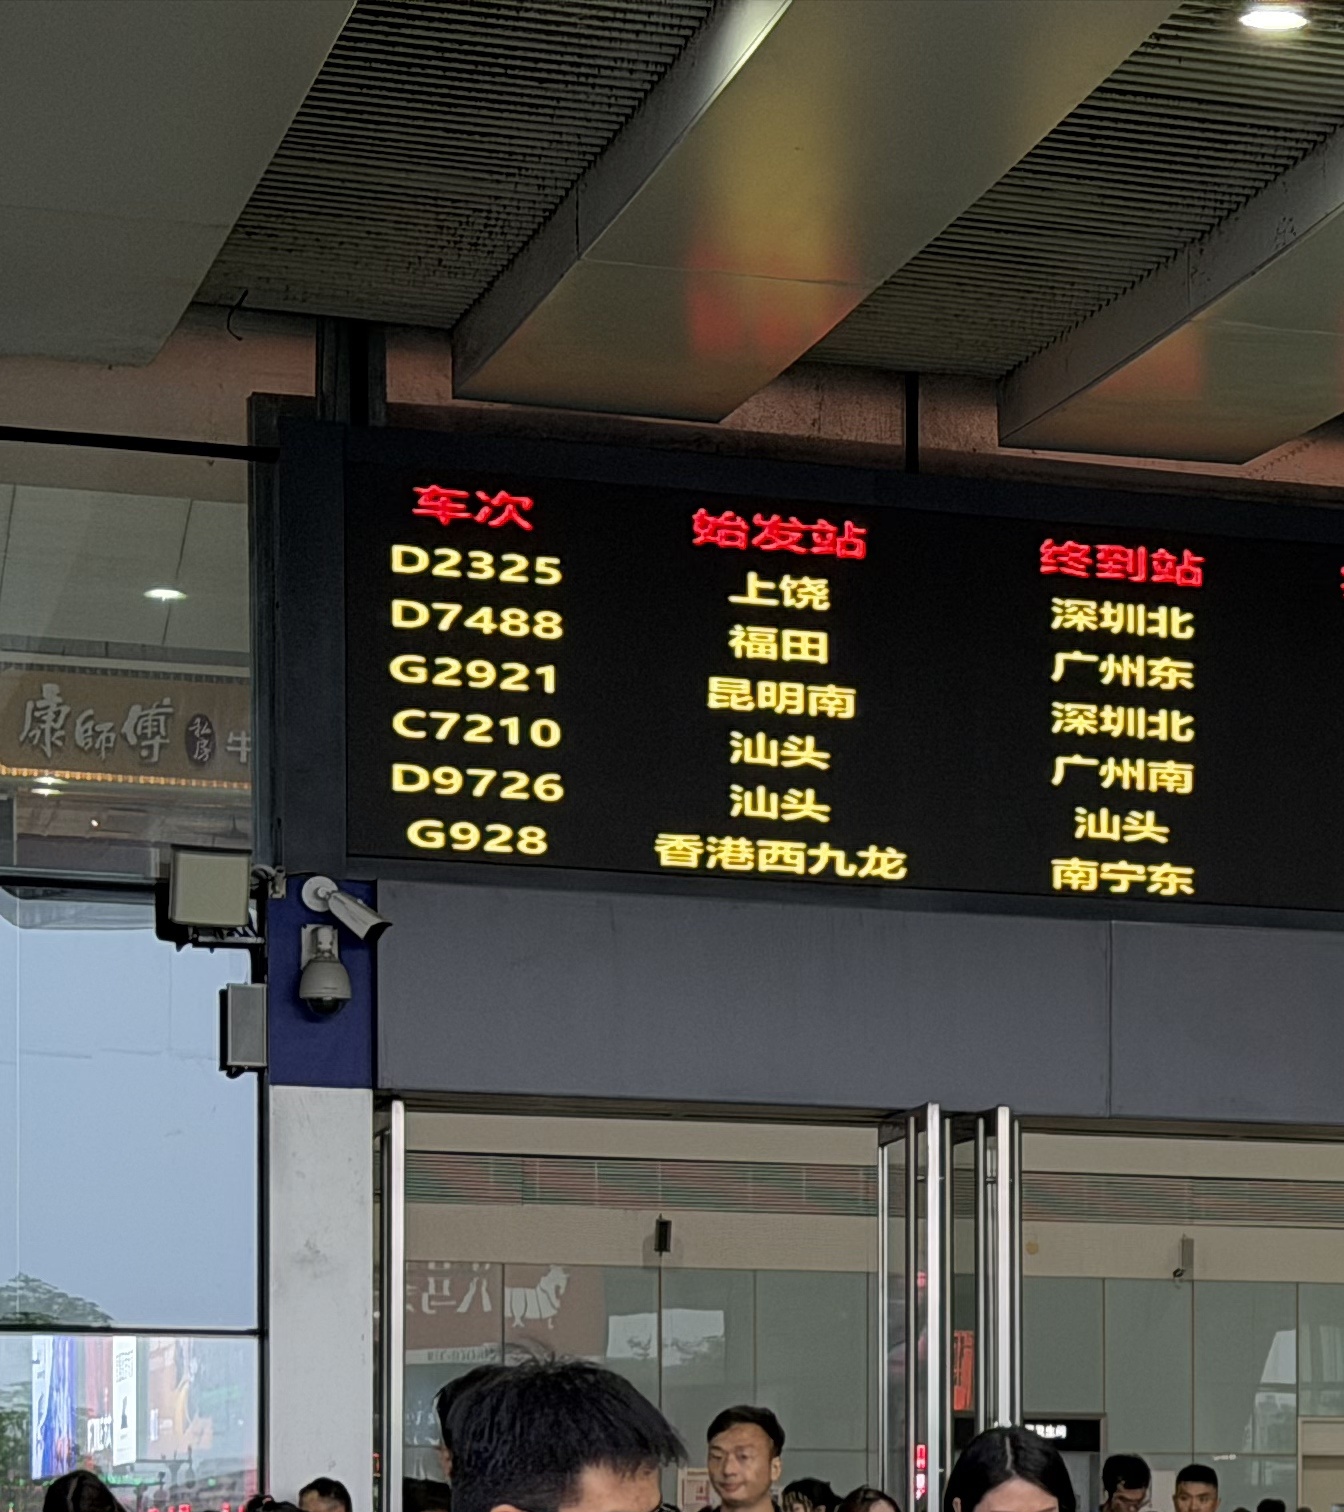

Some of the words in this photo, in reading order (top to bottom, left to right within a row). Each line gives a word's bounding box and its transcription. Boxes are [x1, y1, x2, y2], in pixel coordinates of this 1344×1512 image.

[412, 485, 533, 530] 车次
[692, 508, 866, 559] 始发站
[1040, 539, 1204, 587] 终到站
[392, 545, 562, 585] D2325
[728, 572, 830, 610] 上饶
[1051, 598, 1194, 639] 深圳北
[392, 600, 563, 639] D7488
[729, 624, 828, 664] 福田
[1051, 651, 1194, 689] 广州东
[390, 655, 555, 693] G2921
[707, 677, 856, 718] 昆明南
[1052, 702, 1194, 742] 深圳北
[393, 709, 560, 747] C7210
[730, 731, 830, 770] 汕头
[1052, 754, 1194, 793] 广州南
[392, 764, 563, 801] D9726
[730, 784, 831, 822] 汕头
[1075, 807, 1170, 843] 汕头
[407, 820, 547, 854] G928
[654, 834, 907, 879] 香港西九龙
[1051, 859, 1194, 895] 南宁东
